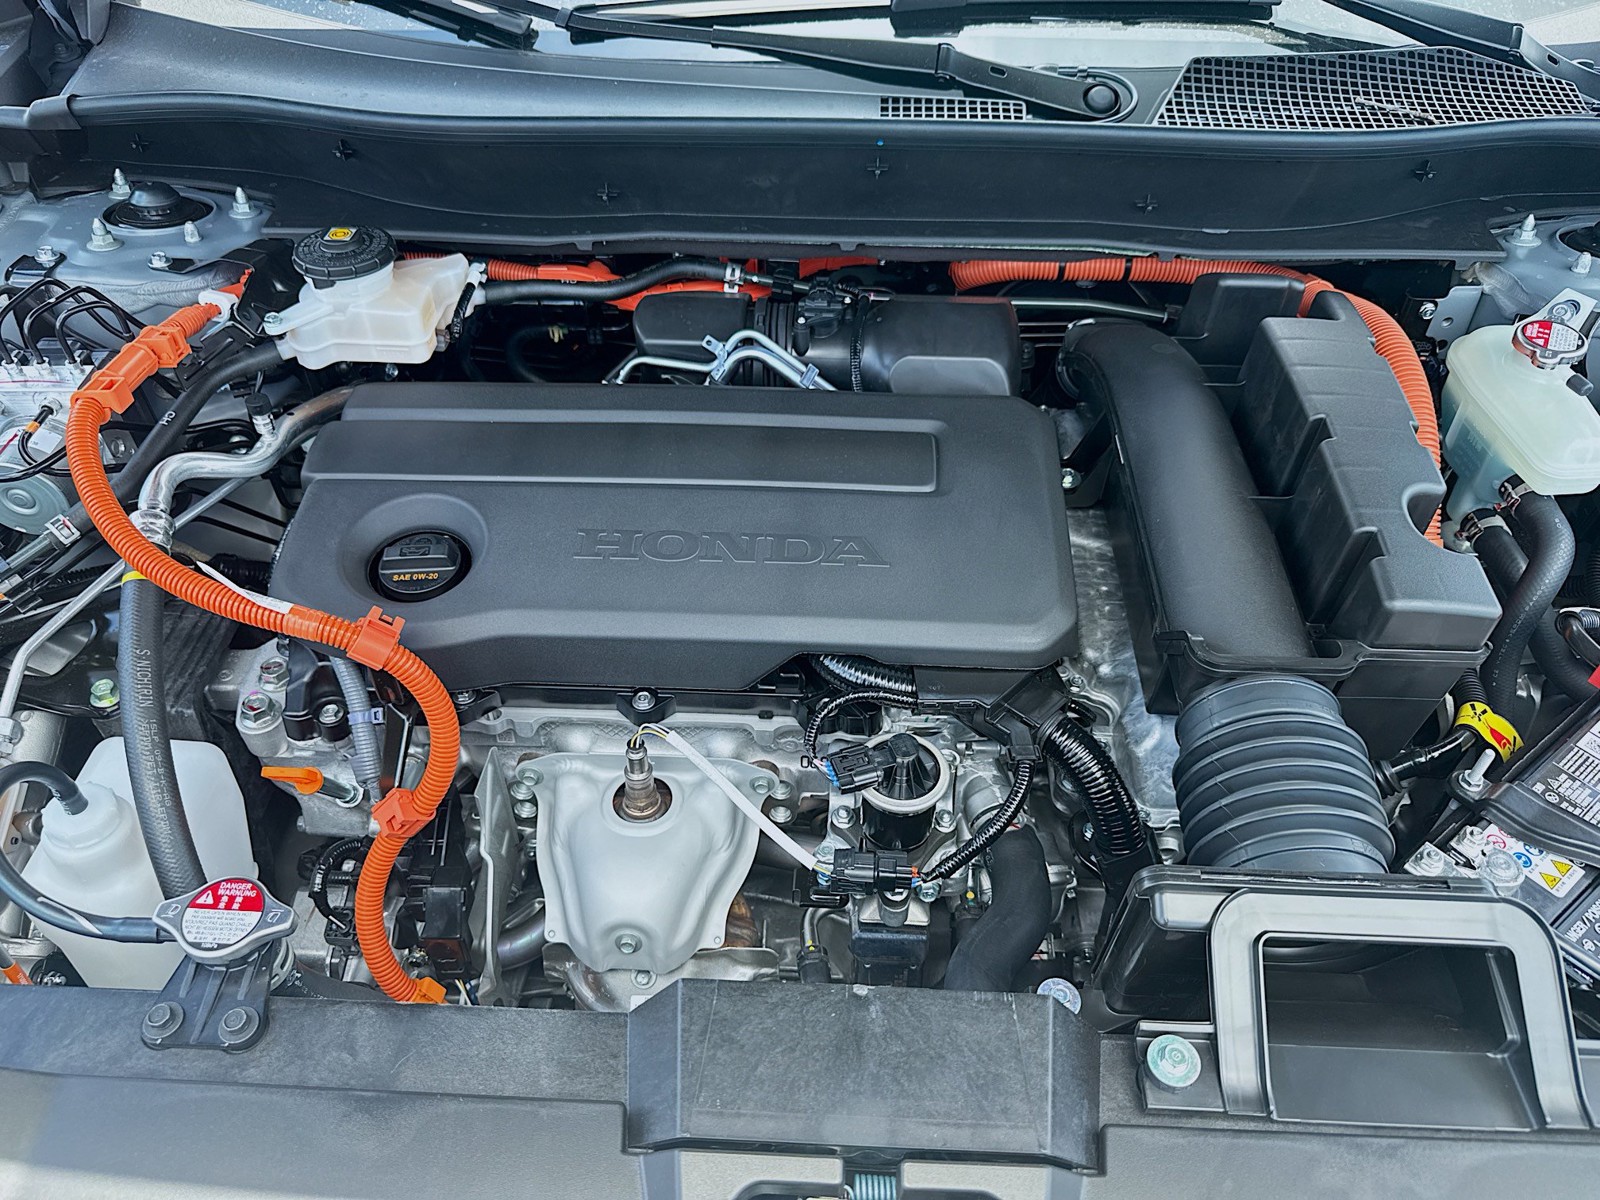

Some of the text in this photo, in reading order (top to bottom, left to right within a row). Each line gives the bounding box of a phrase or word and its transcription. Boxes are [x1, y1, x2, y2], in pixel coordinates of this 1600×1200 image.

[573, 529, 891, 568] HONDA
[412, 572, 439, 580] 0W-20
[219, 881, 253, 890] DANGER
